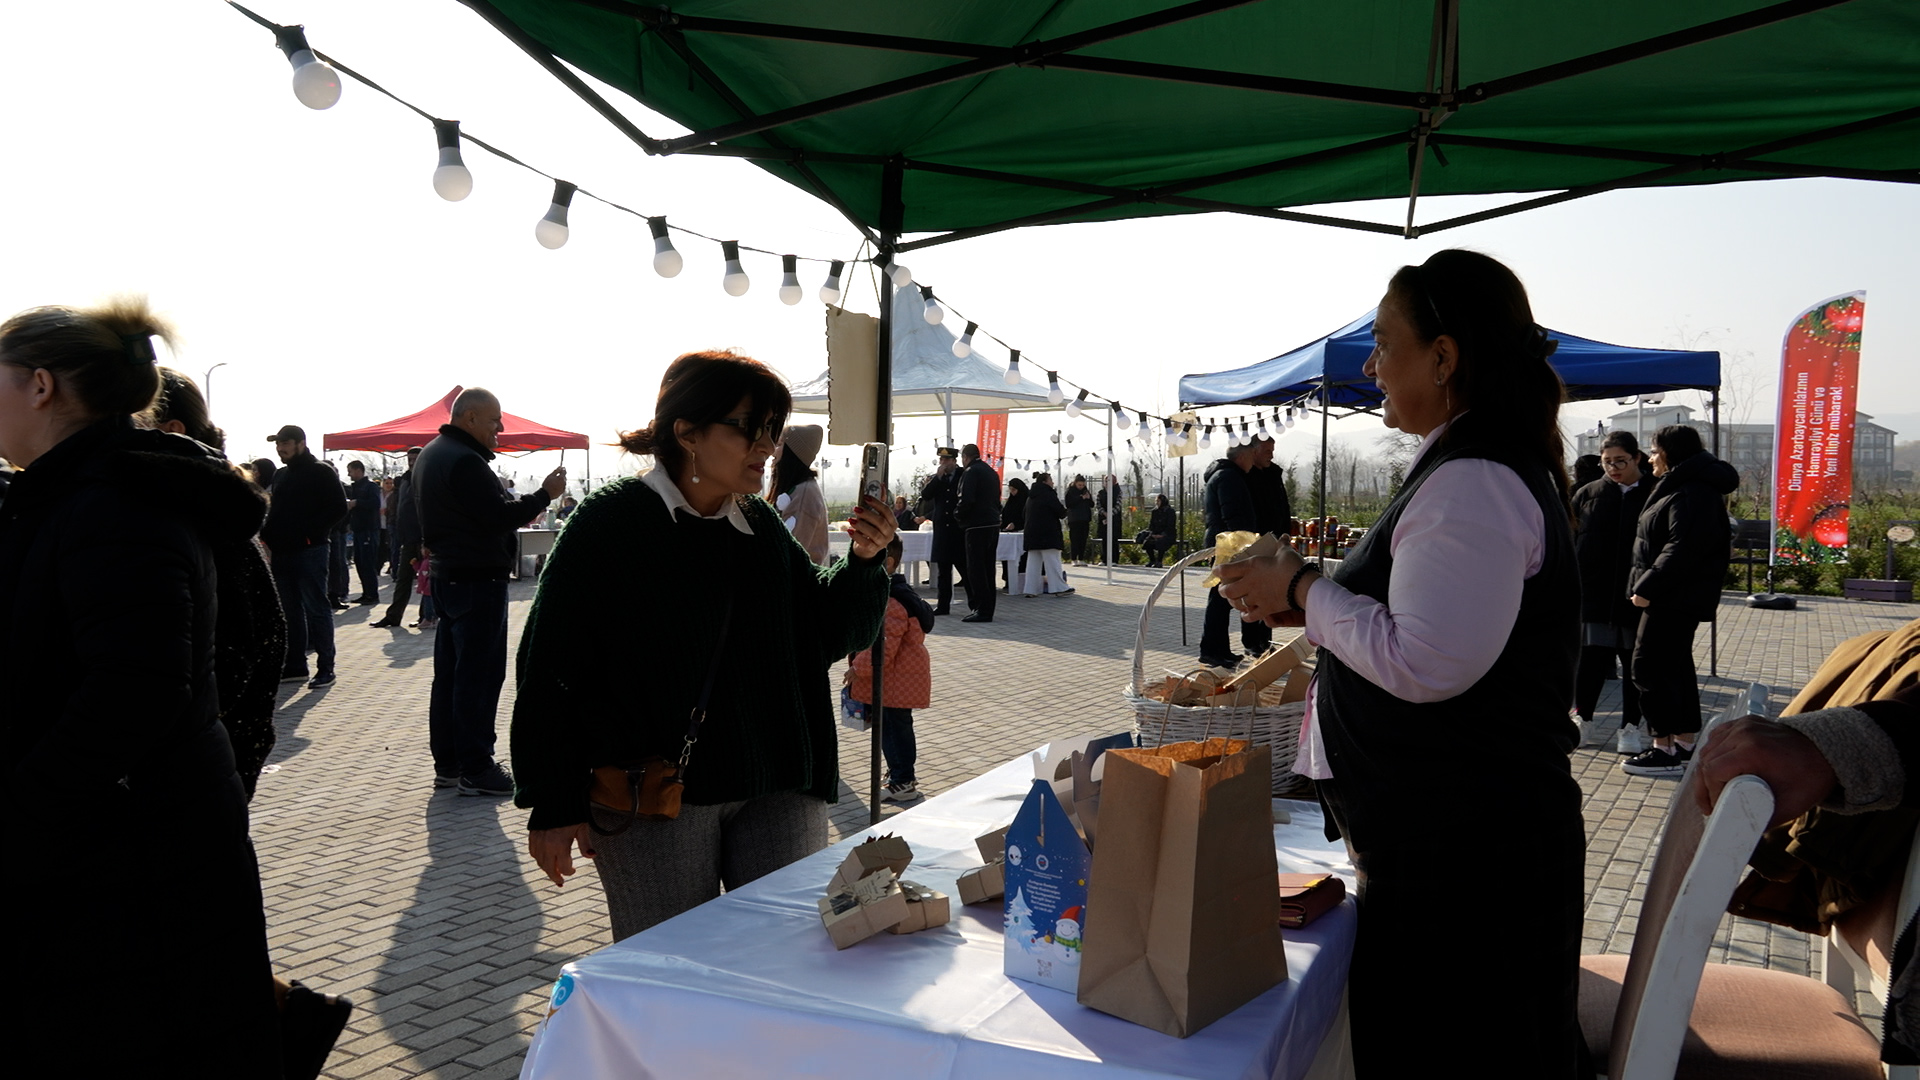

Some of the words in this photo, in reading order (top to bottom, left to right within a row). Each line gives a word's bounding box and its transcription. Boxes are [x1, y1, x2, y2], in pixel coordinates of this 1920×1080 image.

[1815, 387, 1825, 398] və
[1810, 401, 1824, 425] Günü
[1828, 386, 1842, 430] mübarək!
[1806, 427, 1824, 477] Həmrəyliyi
[1788, 463, 1804, 491] Dünya
[1823, 458, 1838, 478] Yeni
